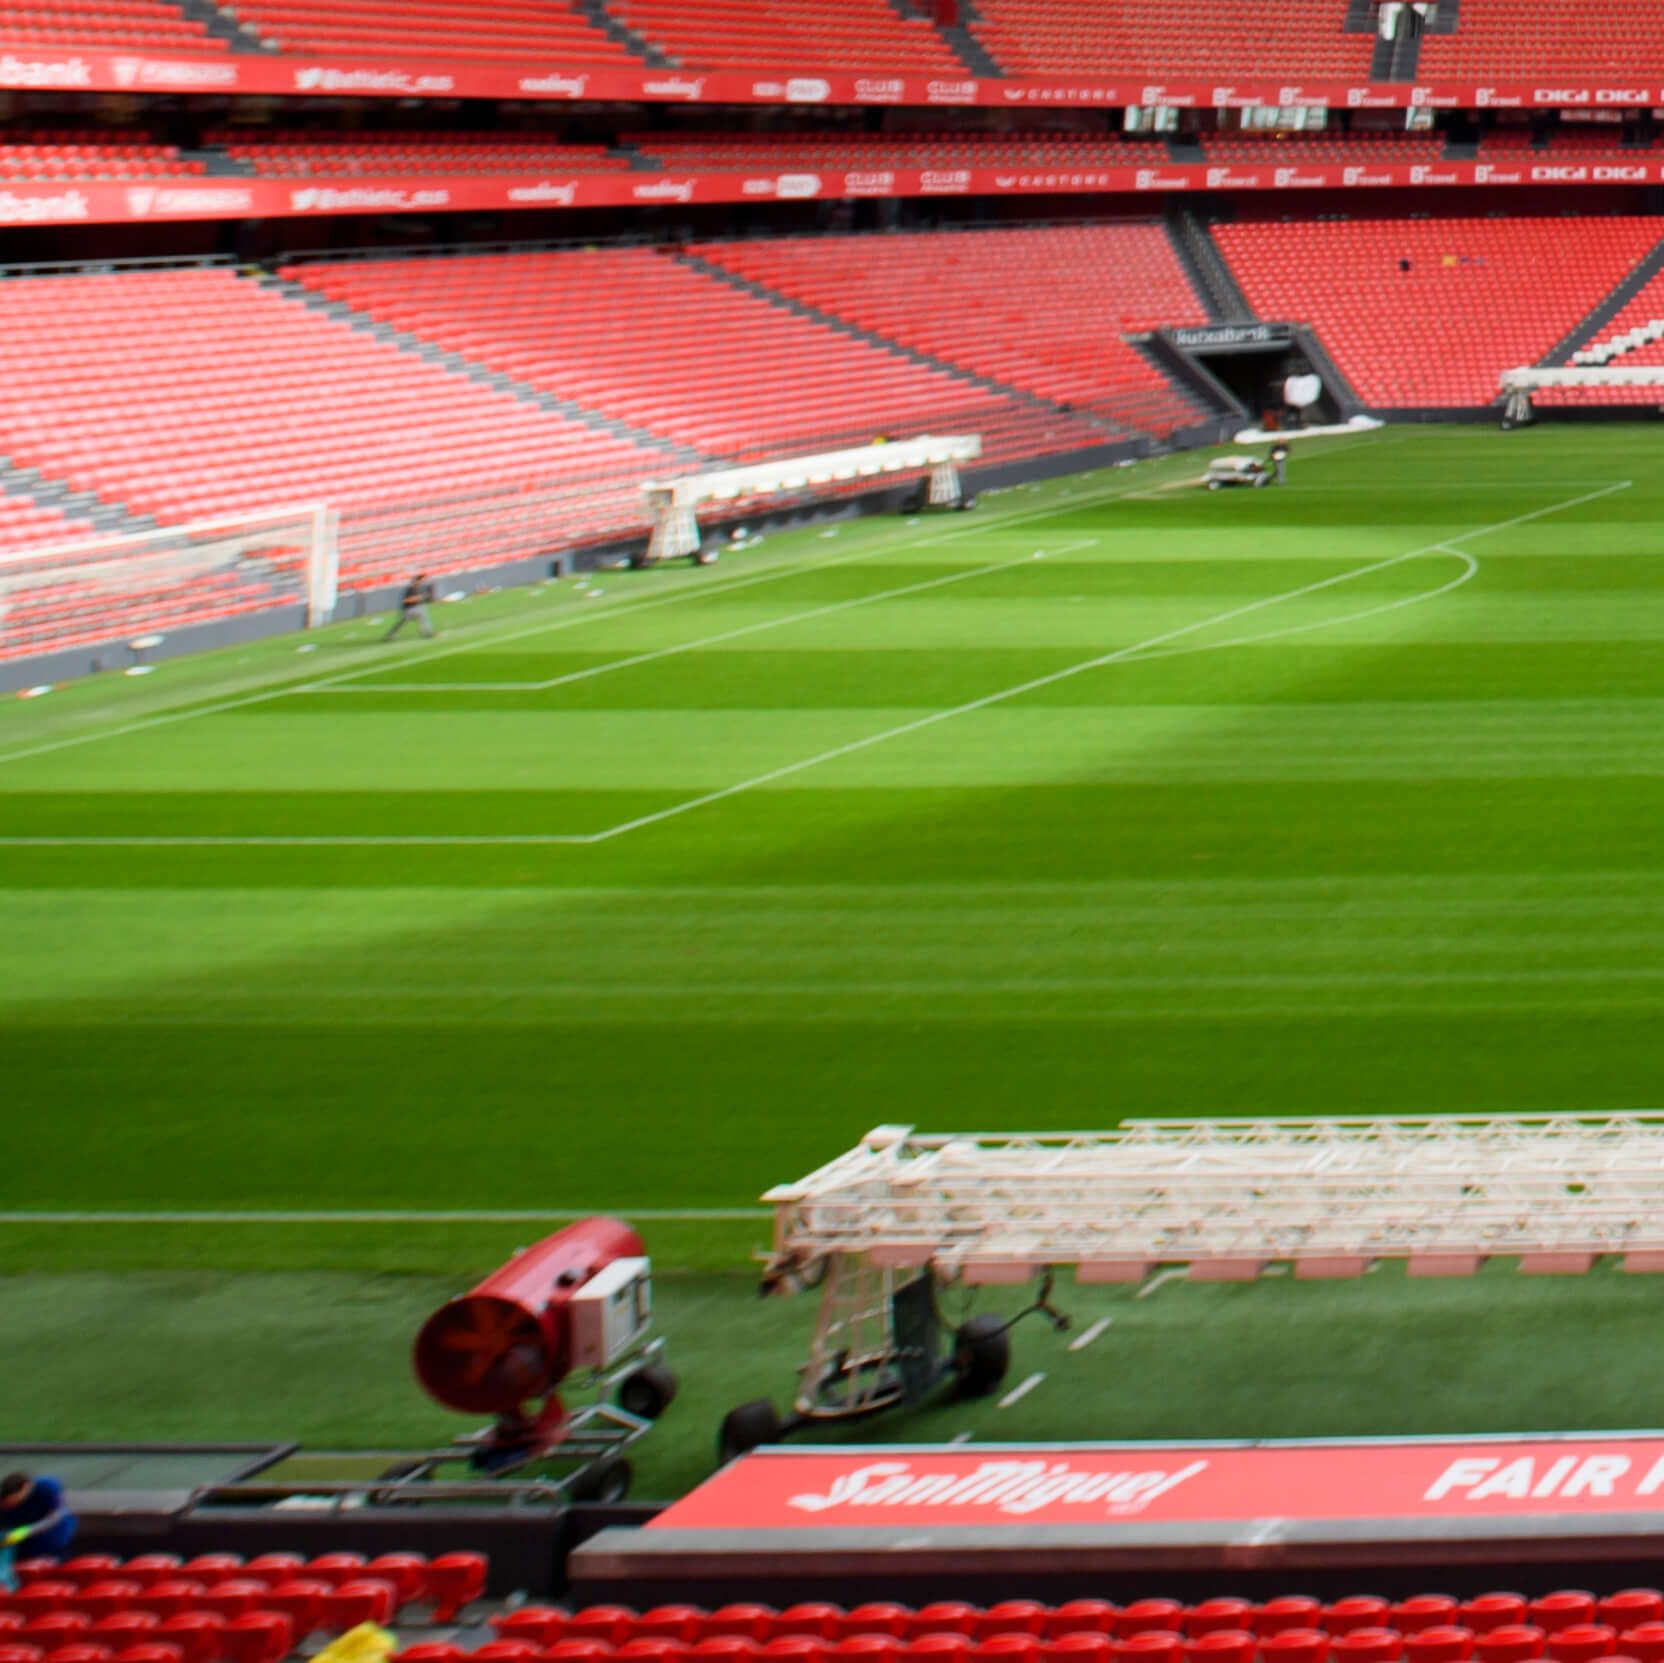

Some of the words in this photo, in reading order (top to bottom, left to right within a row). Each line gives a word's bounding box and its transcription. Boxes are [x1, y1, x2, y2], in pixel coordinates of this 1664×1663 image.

[0, 54, 91, 86] bank
[0, 190, 89, 222] bank
[787, 1460, 1210, 1514] SanMiguel
[1423, 1453, 1632, 1501] FAIR
